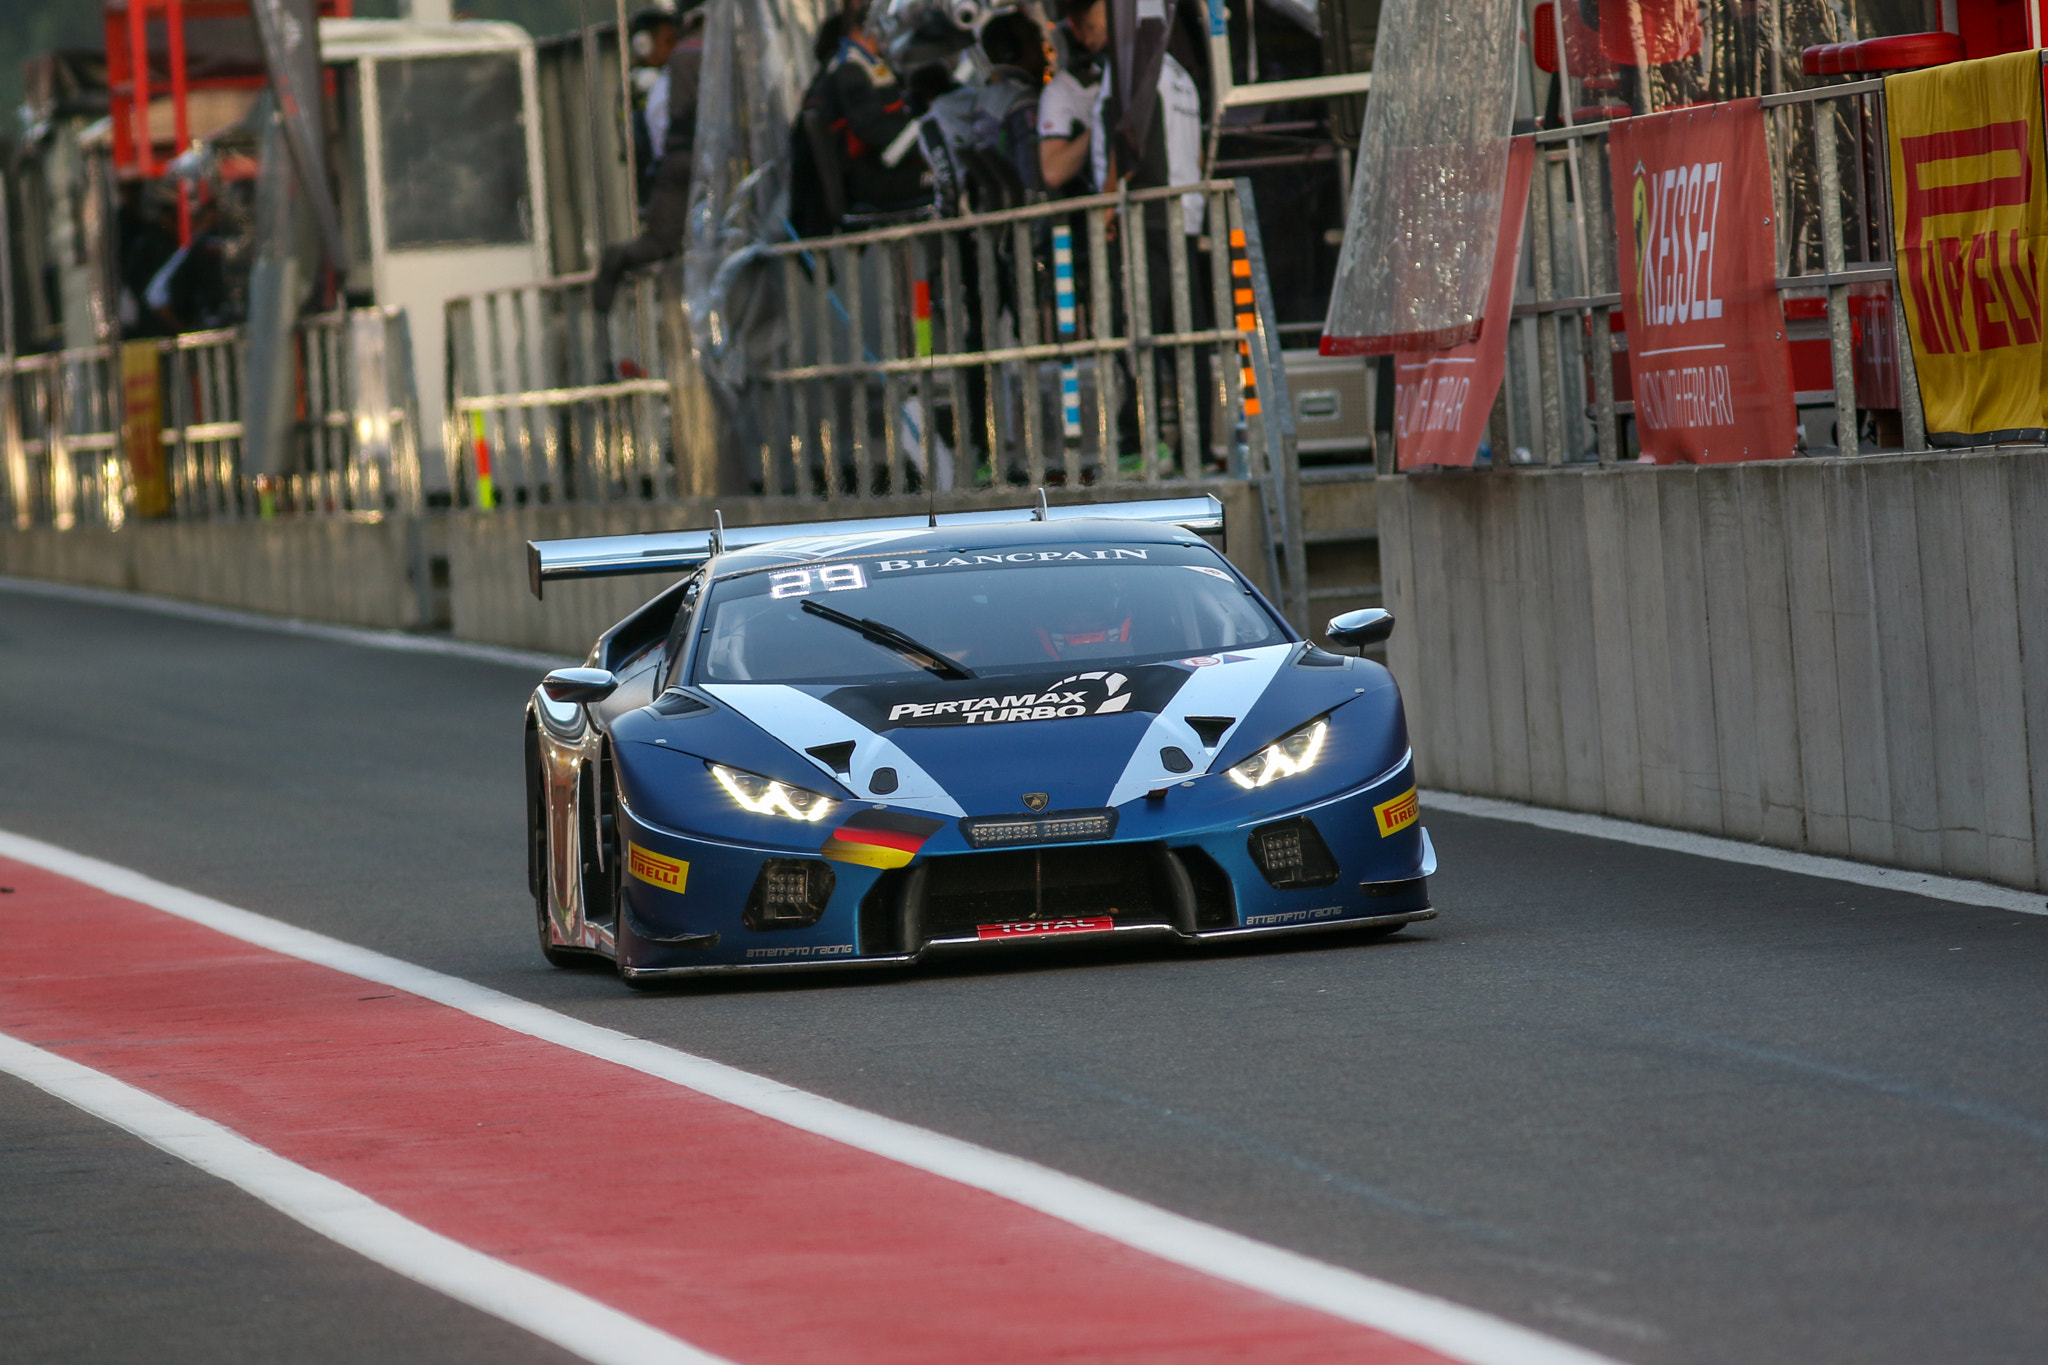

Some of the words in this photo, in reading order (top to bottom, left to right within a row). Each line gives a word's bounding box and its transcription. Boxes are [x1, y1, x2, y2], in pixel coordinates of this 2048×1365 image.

[1644, 161, 1723, 327] KESSEL
[874, 548, 1149, 573] BLANCPAIN
[769, 563, 867, 600] 29
[888, 690, 1089, 721] PERTAMAX
[962, 705, 1087, 724] TURBO
[631, 848, 680, 886] PIRELLI
[995, 919, 1095, 933] TOTAL
